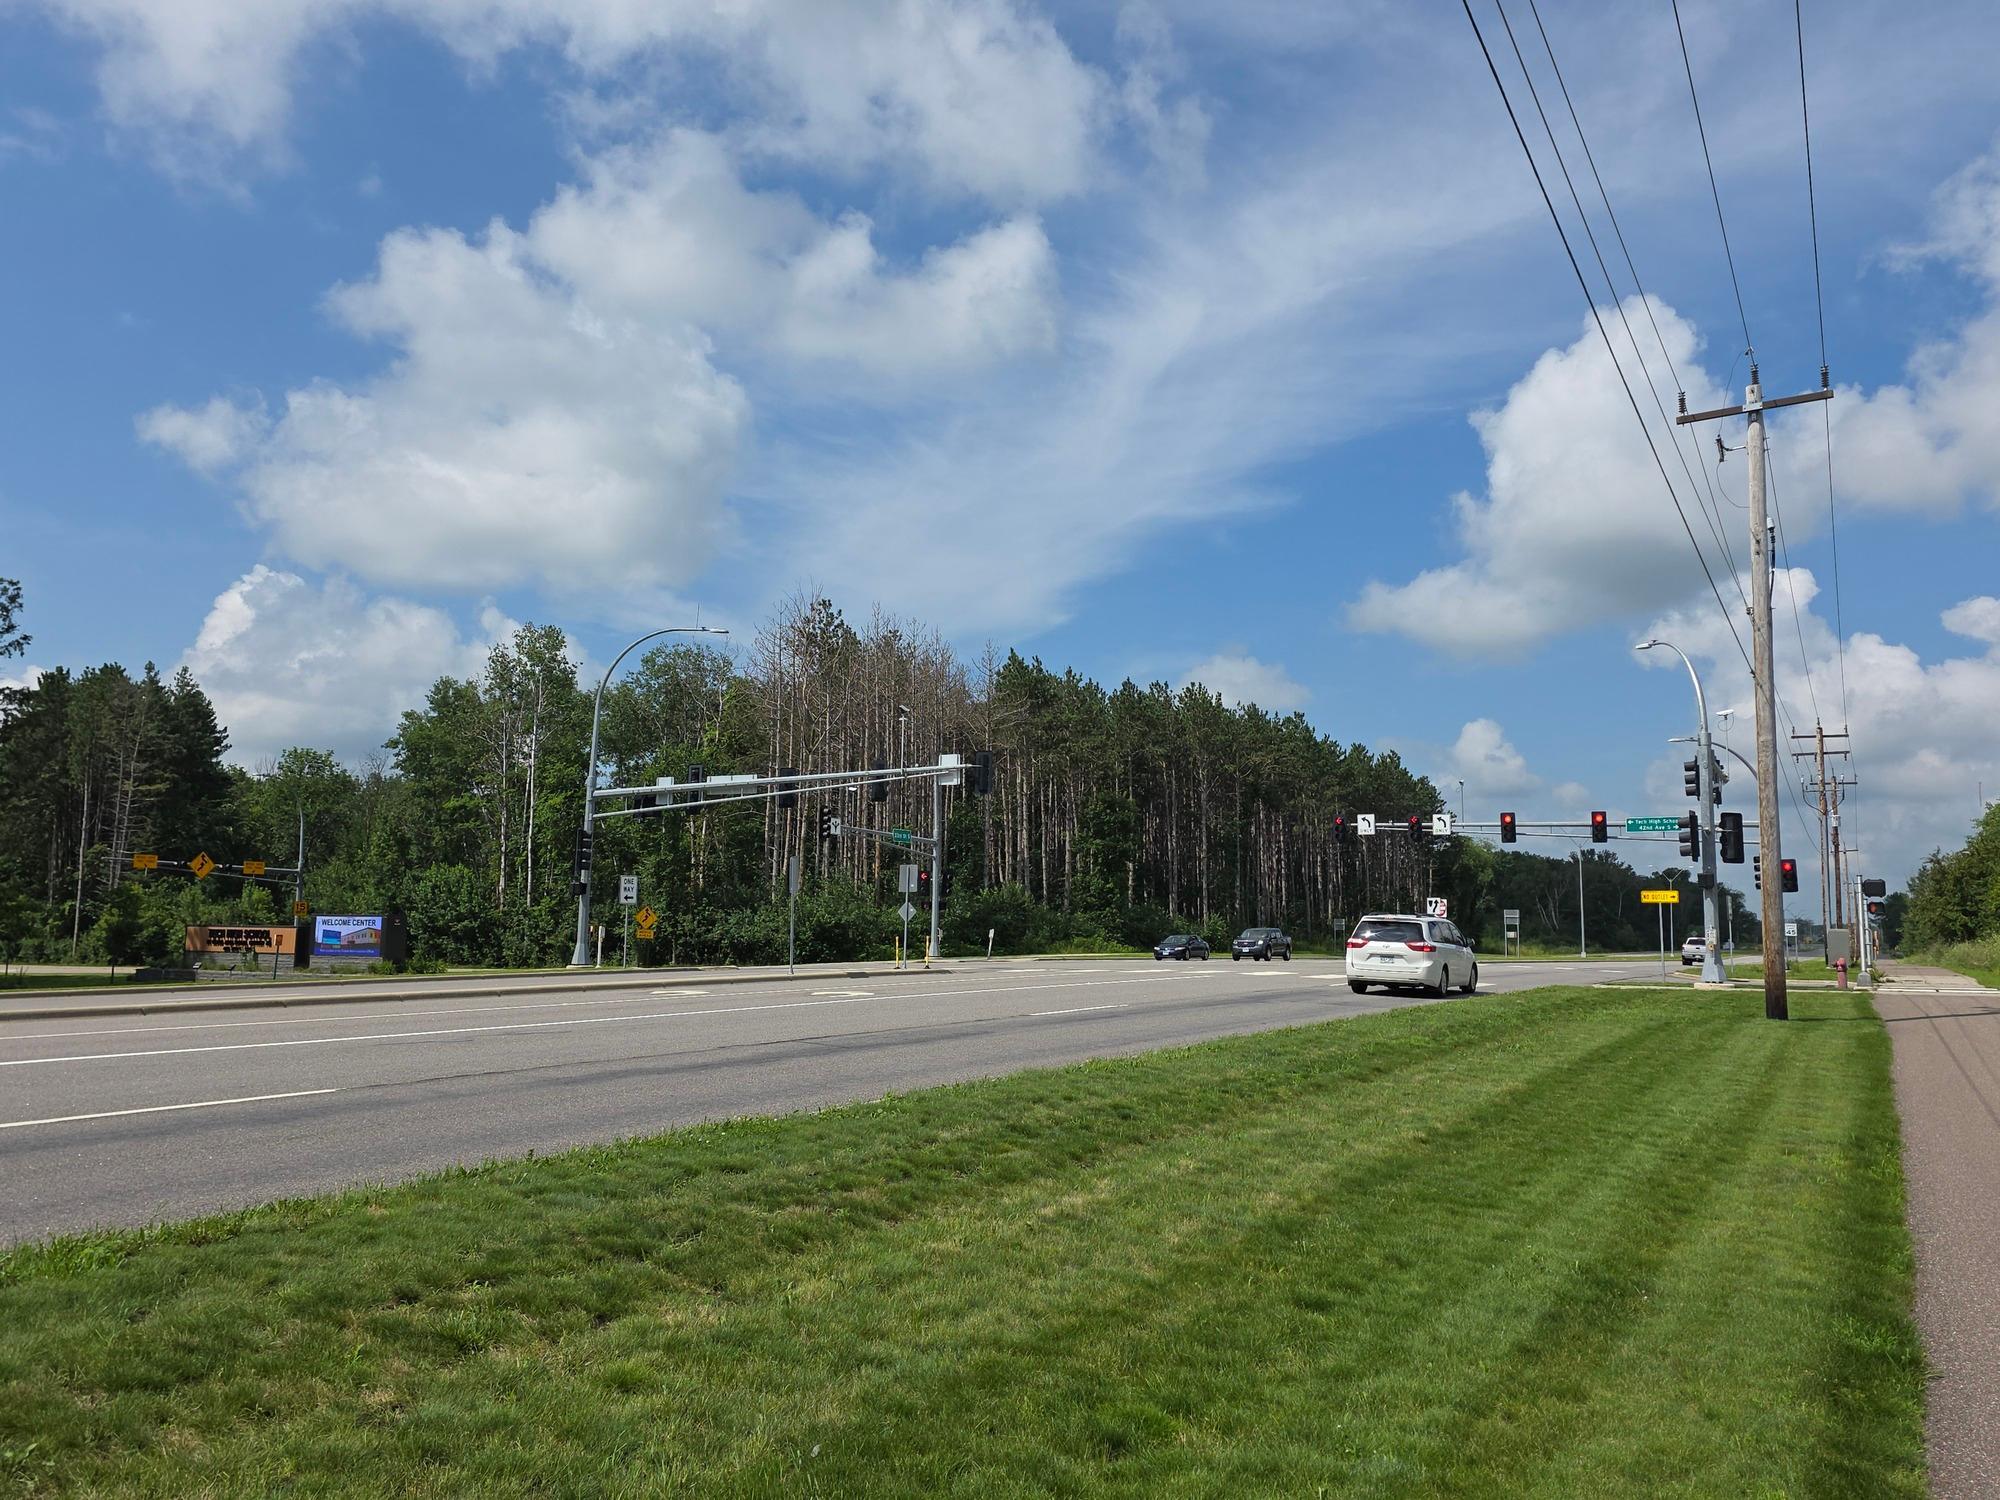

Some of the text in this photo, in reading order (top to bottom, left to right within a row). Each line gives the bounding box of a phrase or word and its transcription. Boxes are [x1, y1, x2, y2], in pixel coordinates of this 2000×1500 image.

[296, 903, 306, 911] 15
[321, 918, 376, 927] WELCOME CENTER
